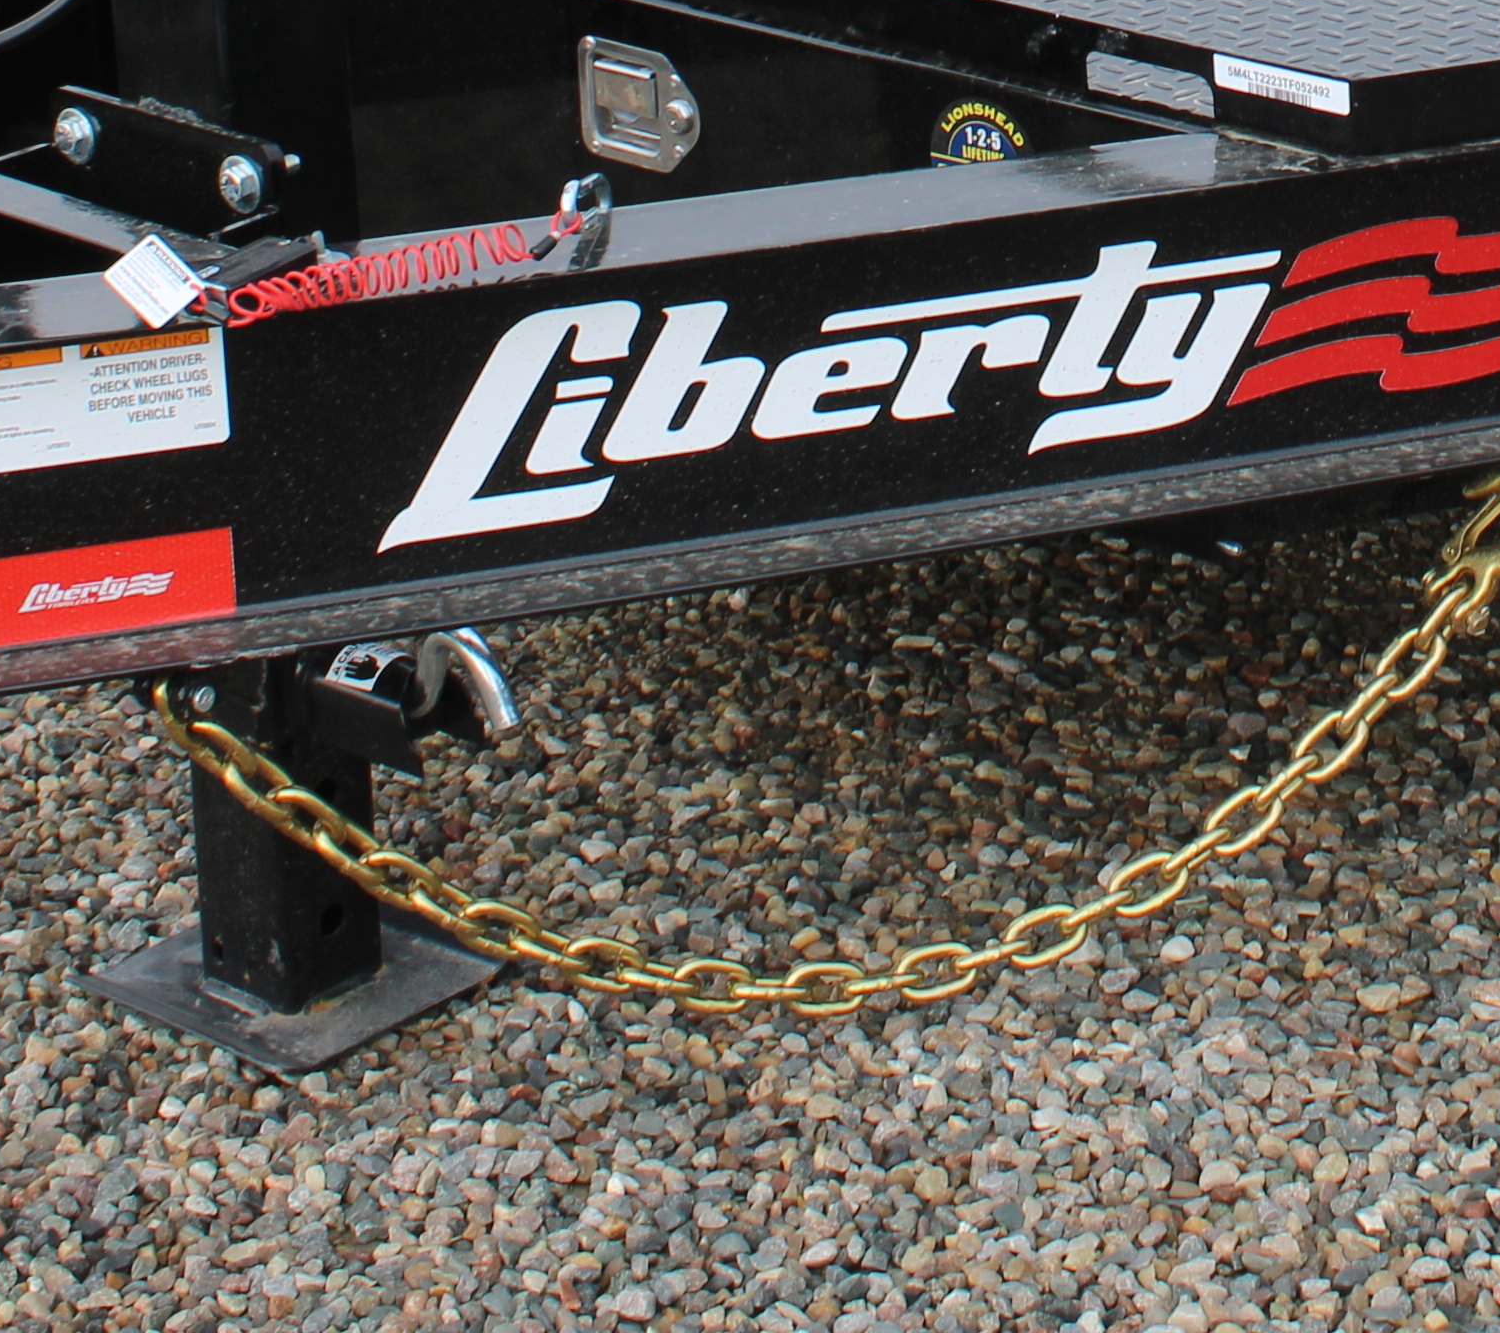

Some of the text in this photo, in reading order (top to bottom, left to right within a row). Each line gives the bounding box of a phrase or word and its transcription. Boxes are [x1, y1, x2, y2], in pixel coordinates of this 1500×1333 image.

[941, 102, 1025, 147] LIONSHEAD
[107, 333, 203, 354] WARNING
[89, 353, 206, 378] -ATTENTION DRIVER-
[90, 368, 209, 396] CHECK WHEEL LUGS
[88, 384, 213, 412] BEFORE MOVING THIS
[377, 240, 1281, 554] Liberty
[127, 406, 177, 423] VEHICLE
[18, 575, 131, 614] Liberty
